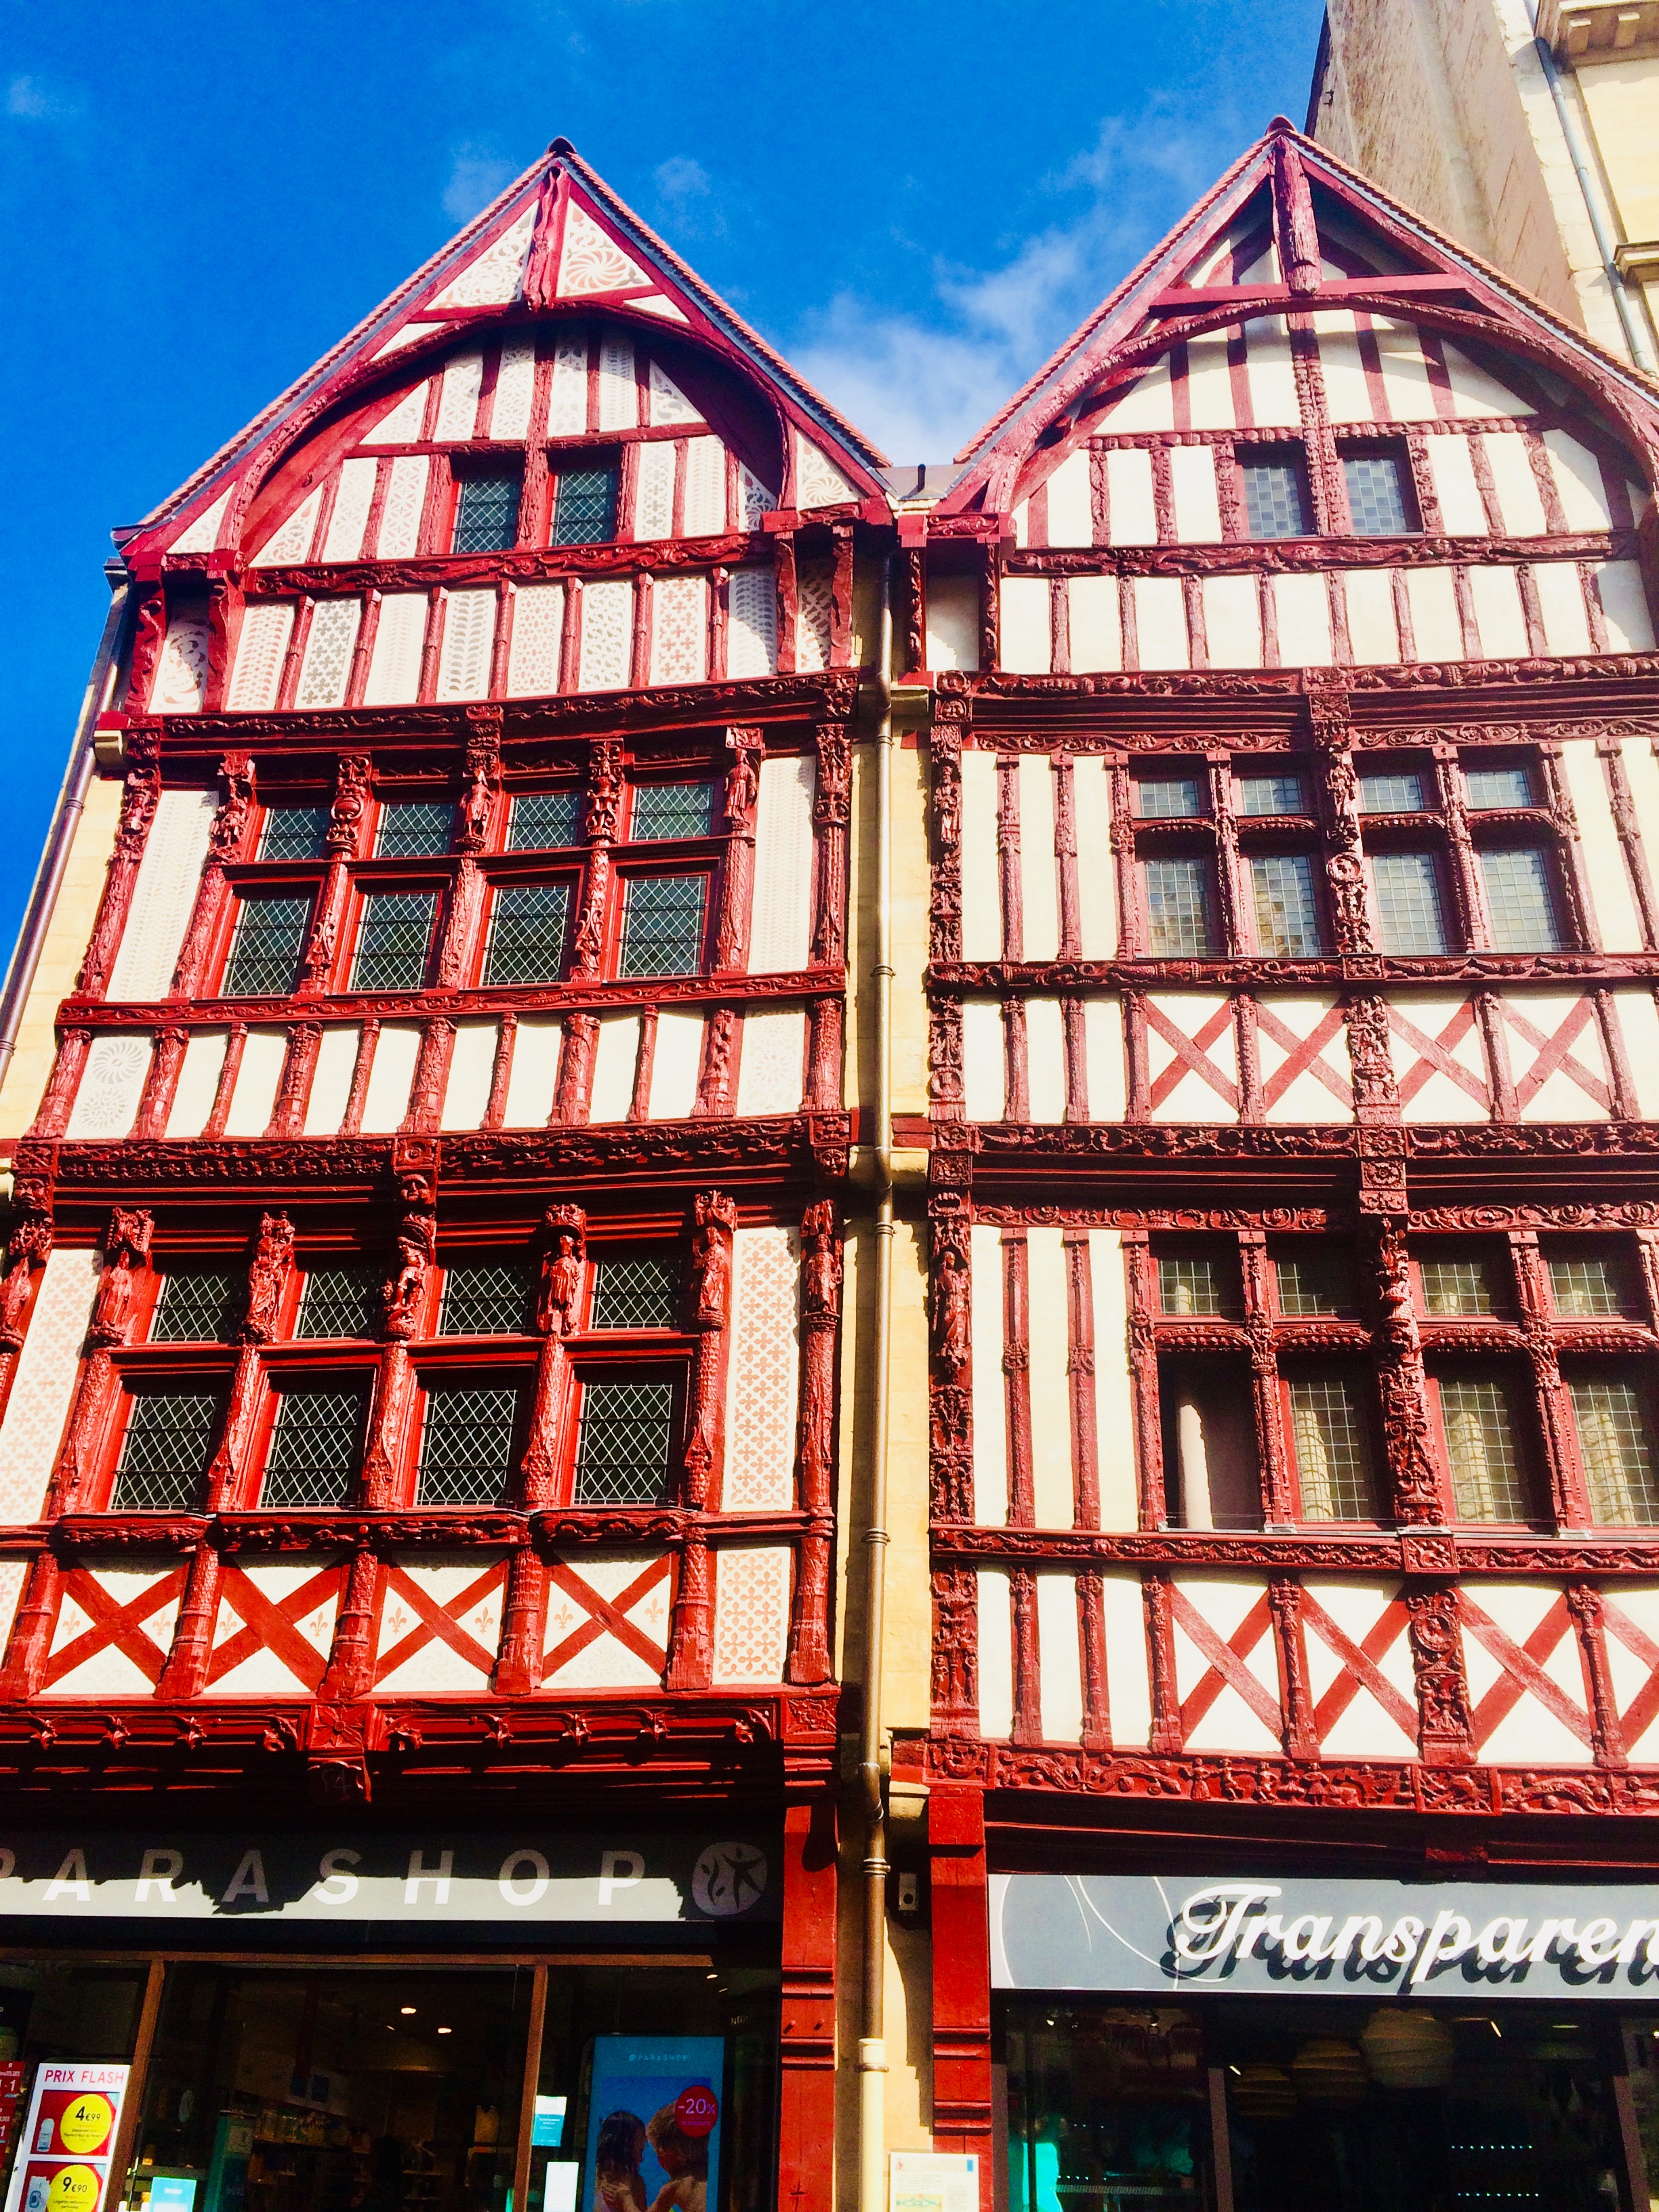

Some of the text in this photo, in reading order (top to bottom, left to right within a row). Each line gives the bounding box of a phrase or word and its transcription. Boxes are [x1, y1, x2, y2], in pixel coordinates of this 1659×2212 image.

[45, 2070, 125, 2084] PRIX FLASH
[678, 2098, 716, 2114] -20%
